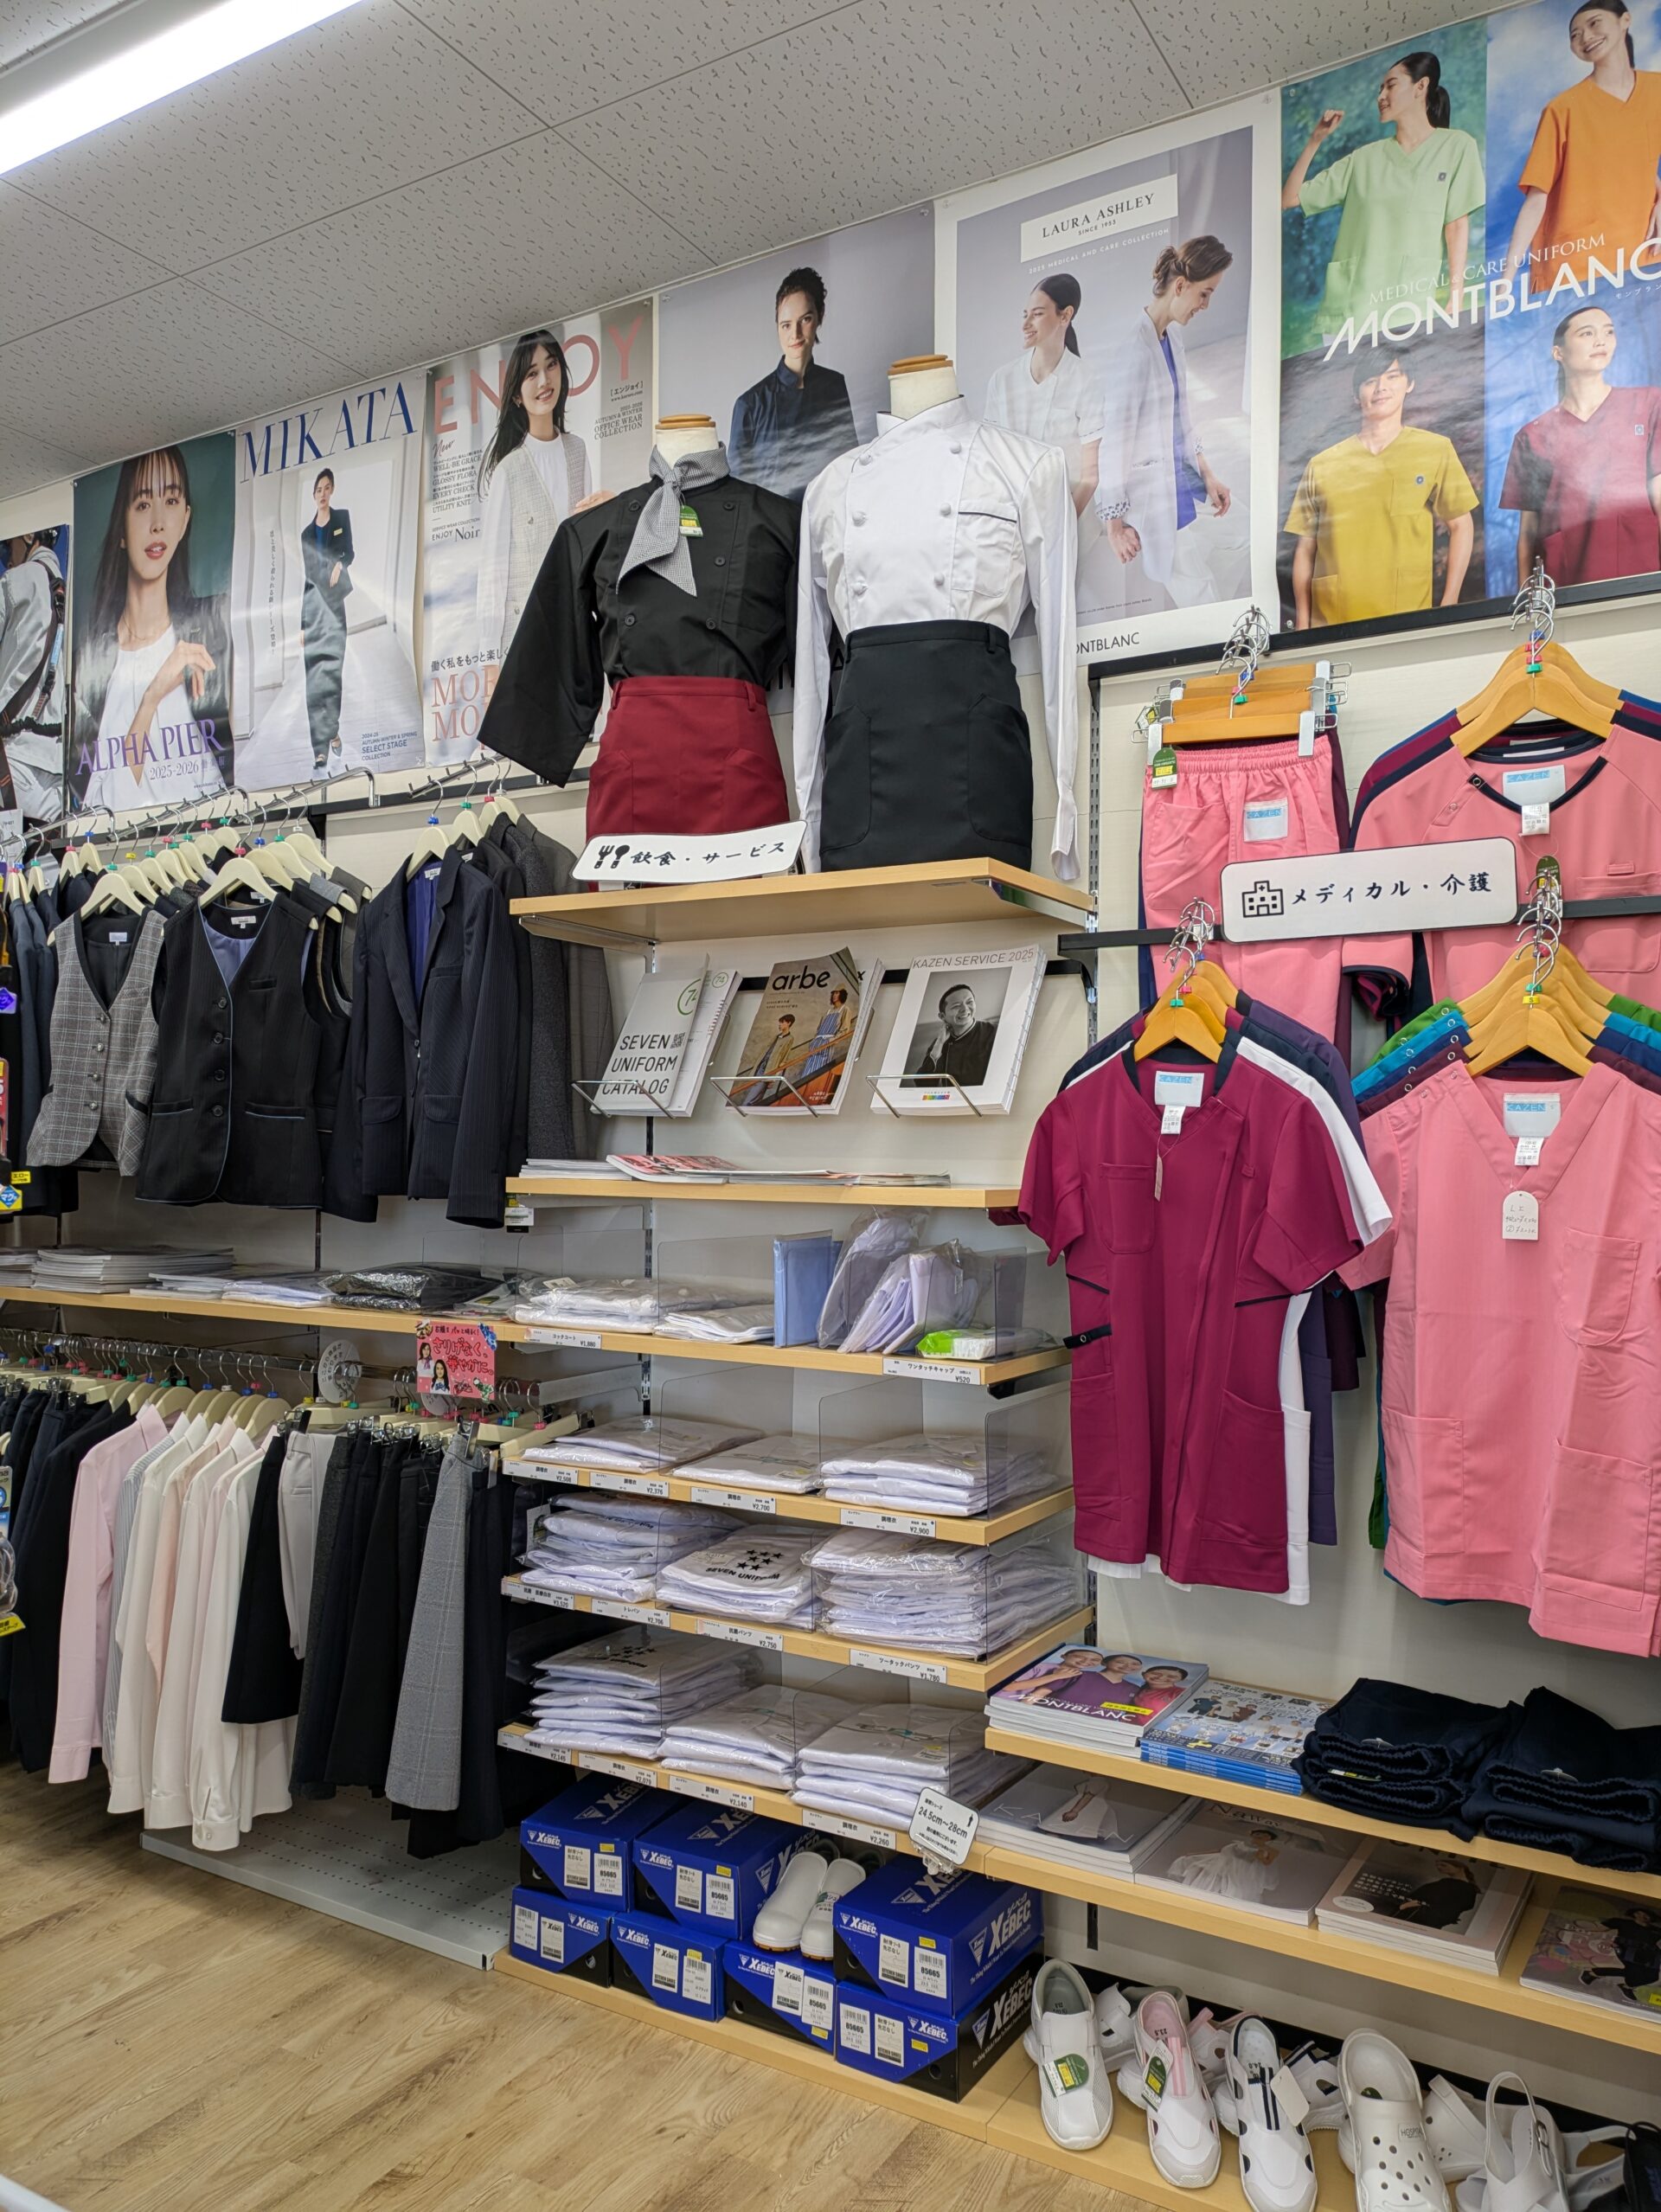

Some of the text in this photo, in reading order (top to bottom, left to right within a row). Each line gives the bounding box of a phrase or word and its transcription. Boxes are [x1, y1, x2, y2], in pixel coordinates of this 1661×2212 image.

[1042, 193, 1155, 239] LAURA ASHLEY
[1078, 225, 1098, 236] SINCE
[1048, 254, 1079, 269] MEDICAL
[1081, 249, 1097, 259] AND
[1100, 242, 1119, 253] CARE
[1122, 228, 1169, 247] COLLECTION
[1369, 272, 1450, 305] MEDICAL
[1462, 258, 1507, 280] CARE
[1515, 232, 1606, 269] UNIFORM
[434, 315, 644, 434] ENOY
[594, 414, 643, 433] OFFICE WEAR
[595, 413, 617, 424] AUTUMN
[622, 407, 643, 416] WINTER
[238, 381, 418, 484] MIKATA
[594, 421, 643, 440] COLLECTION
[461, 454, 482, 465] GRACE
[433, 474, 456, 486] GLOSSY
[457, 470, 478, 481] FLORA
[453, 484, 475, 495] CHECK
[432, 526, 480, 542] ENJOY Noir
[75, 719, 226, 776] ALPHA PIER
[362, 739, 407, 754] SELECT STAGE
[362, 751, 391, 761] COLLECTION
[150, 760, 199, 780] 2025-2026
[631, 842, 786, 866] 飲食・サービス
[1292, 871, 1492, 905] メディカル・介護
[913, 948, 1035, 969] KAZEN SERVICE 2025
[772, 965, 830, 991] arbe
[619, 1035, 670, 1050] SEVEN
[611, 1055, 678, 1073] UNIFORM
[602, 1078, 670, 1095] CATALOG
[446, 1355, 494, 1375] 華やかに。
[907, 1362, 955, 1374] ワンタッチキャップ
[910, 1526, 930, 1535] ¥2,900
[706, 1568, 736, 1576] SEVEN
[760, 1639, 777, 1649] ¥2,750
[879, 1657, 920, 1670] ツータックパンツ
[1009, 1694, 1137, 1722] MONTBLANC
[729, 1798, 747, 1808] ¥2,140
[536, 1832, 561, 1846] XEBEC
[869, 1835, 889, 1846] ¥2,260
[650, 1851, 673, 1867] XEBEC
[576, 1916, 600, 1933] XEBEC
[850, 1916, 876, 1934] XEBEC
[988, 1899, 1032, 1958] XEBEC
[626, 1929, 650, 1946] XEBEC
[748, 1958, 775, 1976] XEBEC
[990, 1977, 1033, 2039] XEBEC
[918, 2021, 947, 2040] XEBEC
